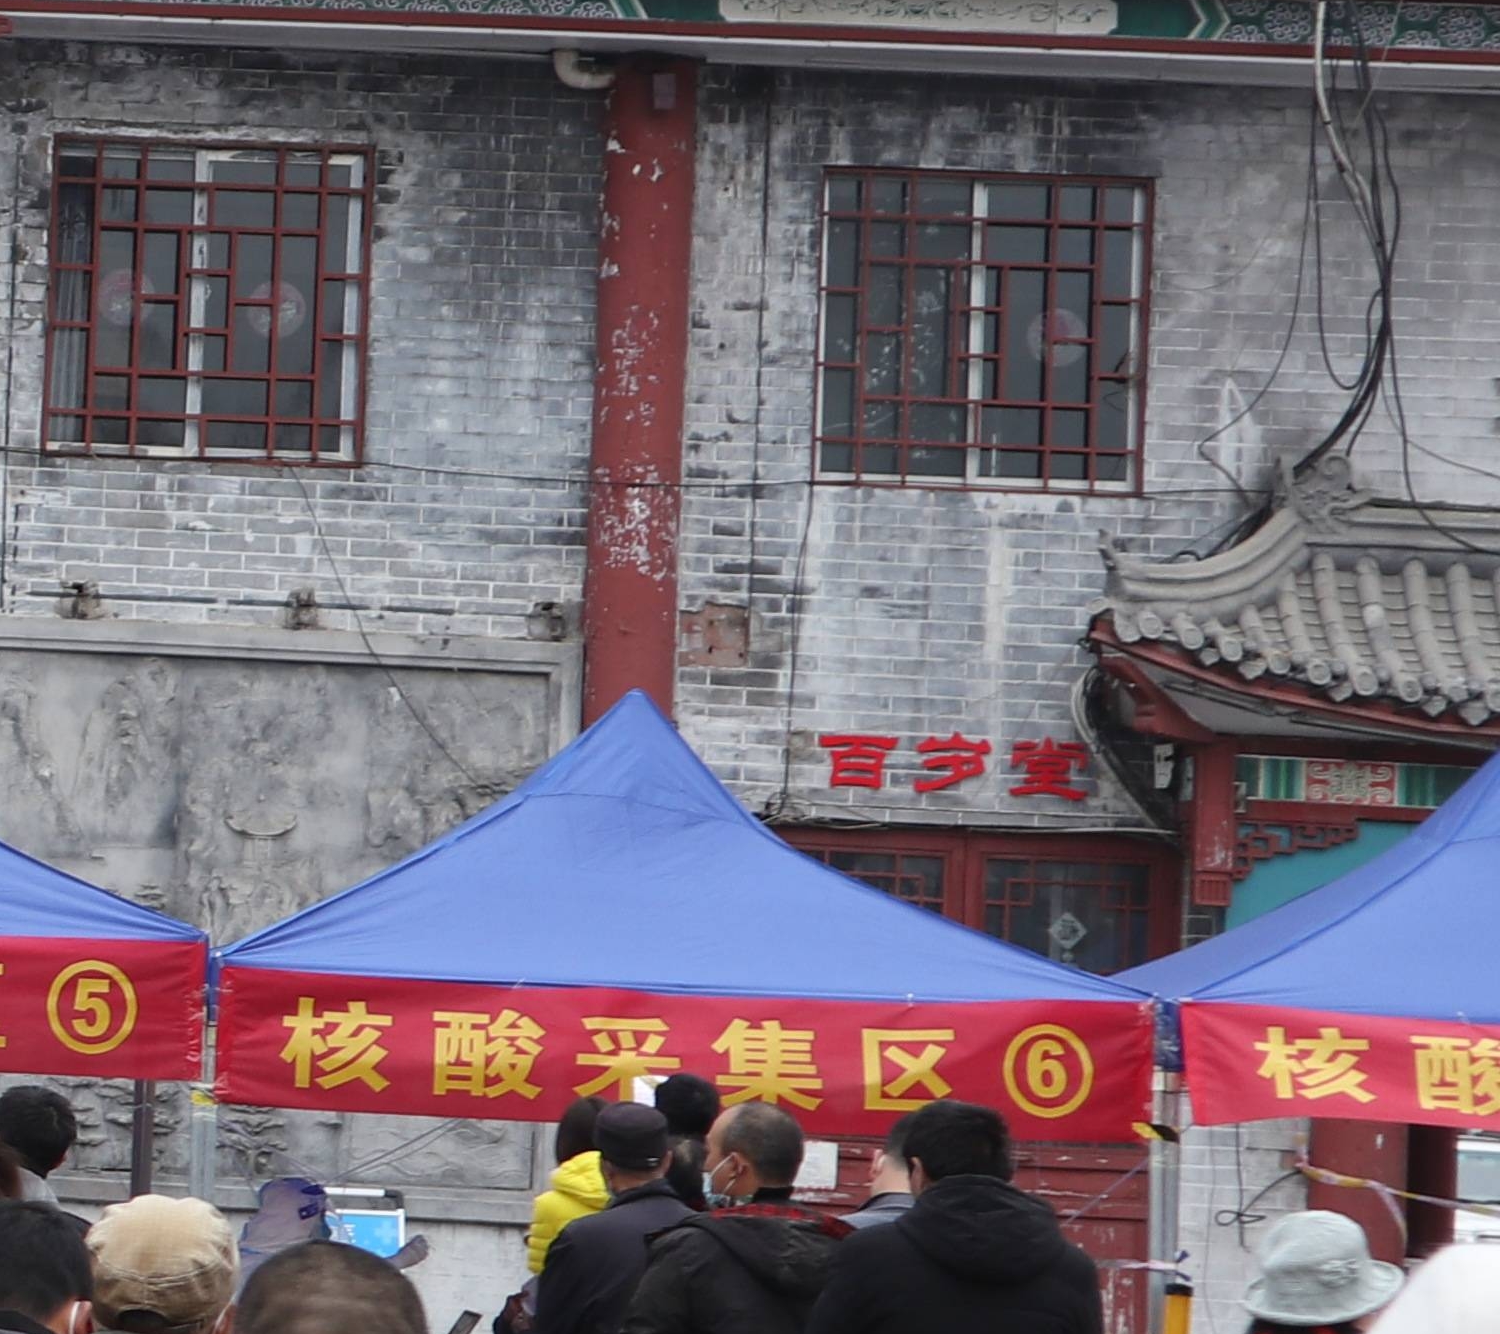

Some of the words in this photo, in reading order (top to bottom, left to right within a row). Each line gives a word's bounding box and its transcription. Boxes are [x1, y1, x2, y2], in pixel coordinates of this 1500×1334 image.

[819, 732, 1090, 801] 百岁堂
[279, 995, 1093, 1119] 核酸采集区⑥
[1253, 1024, 1500, 1116] 核酸
